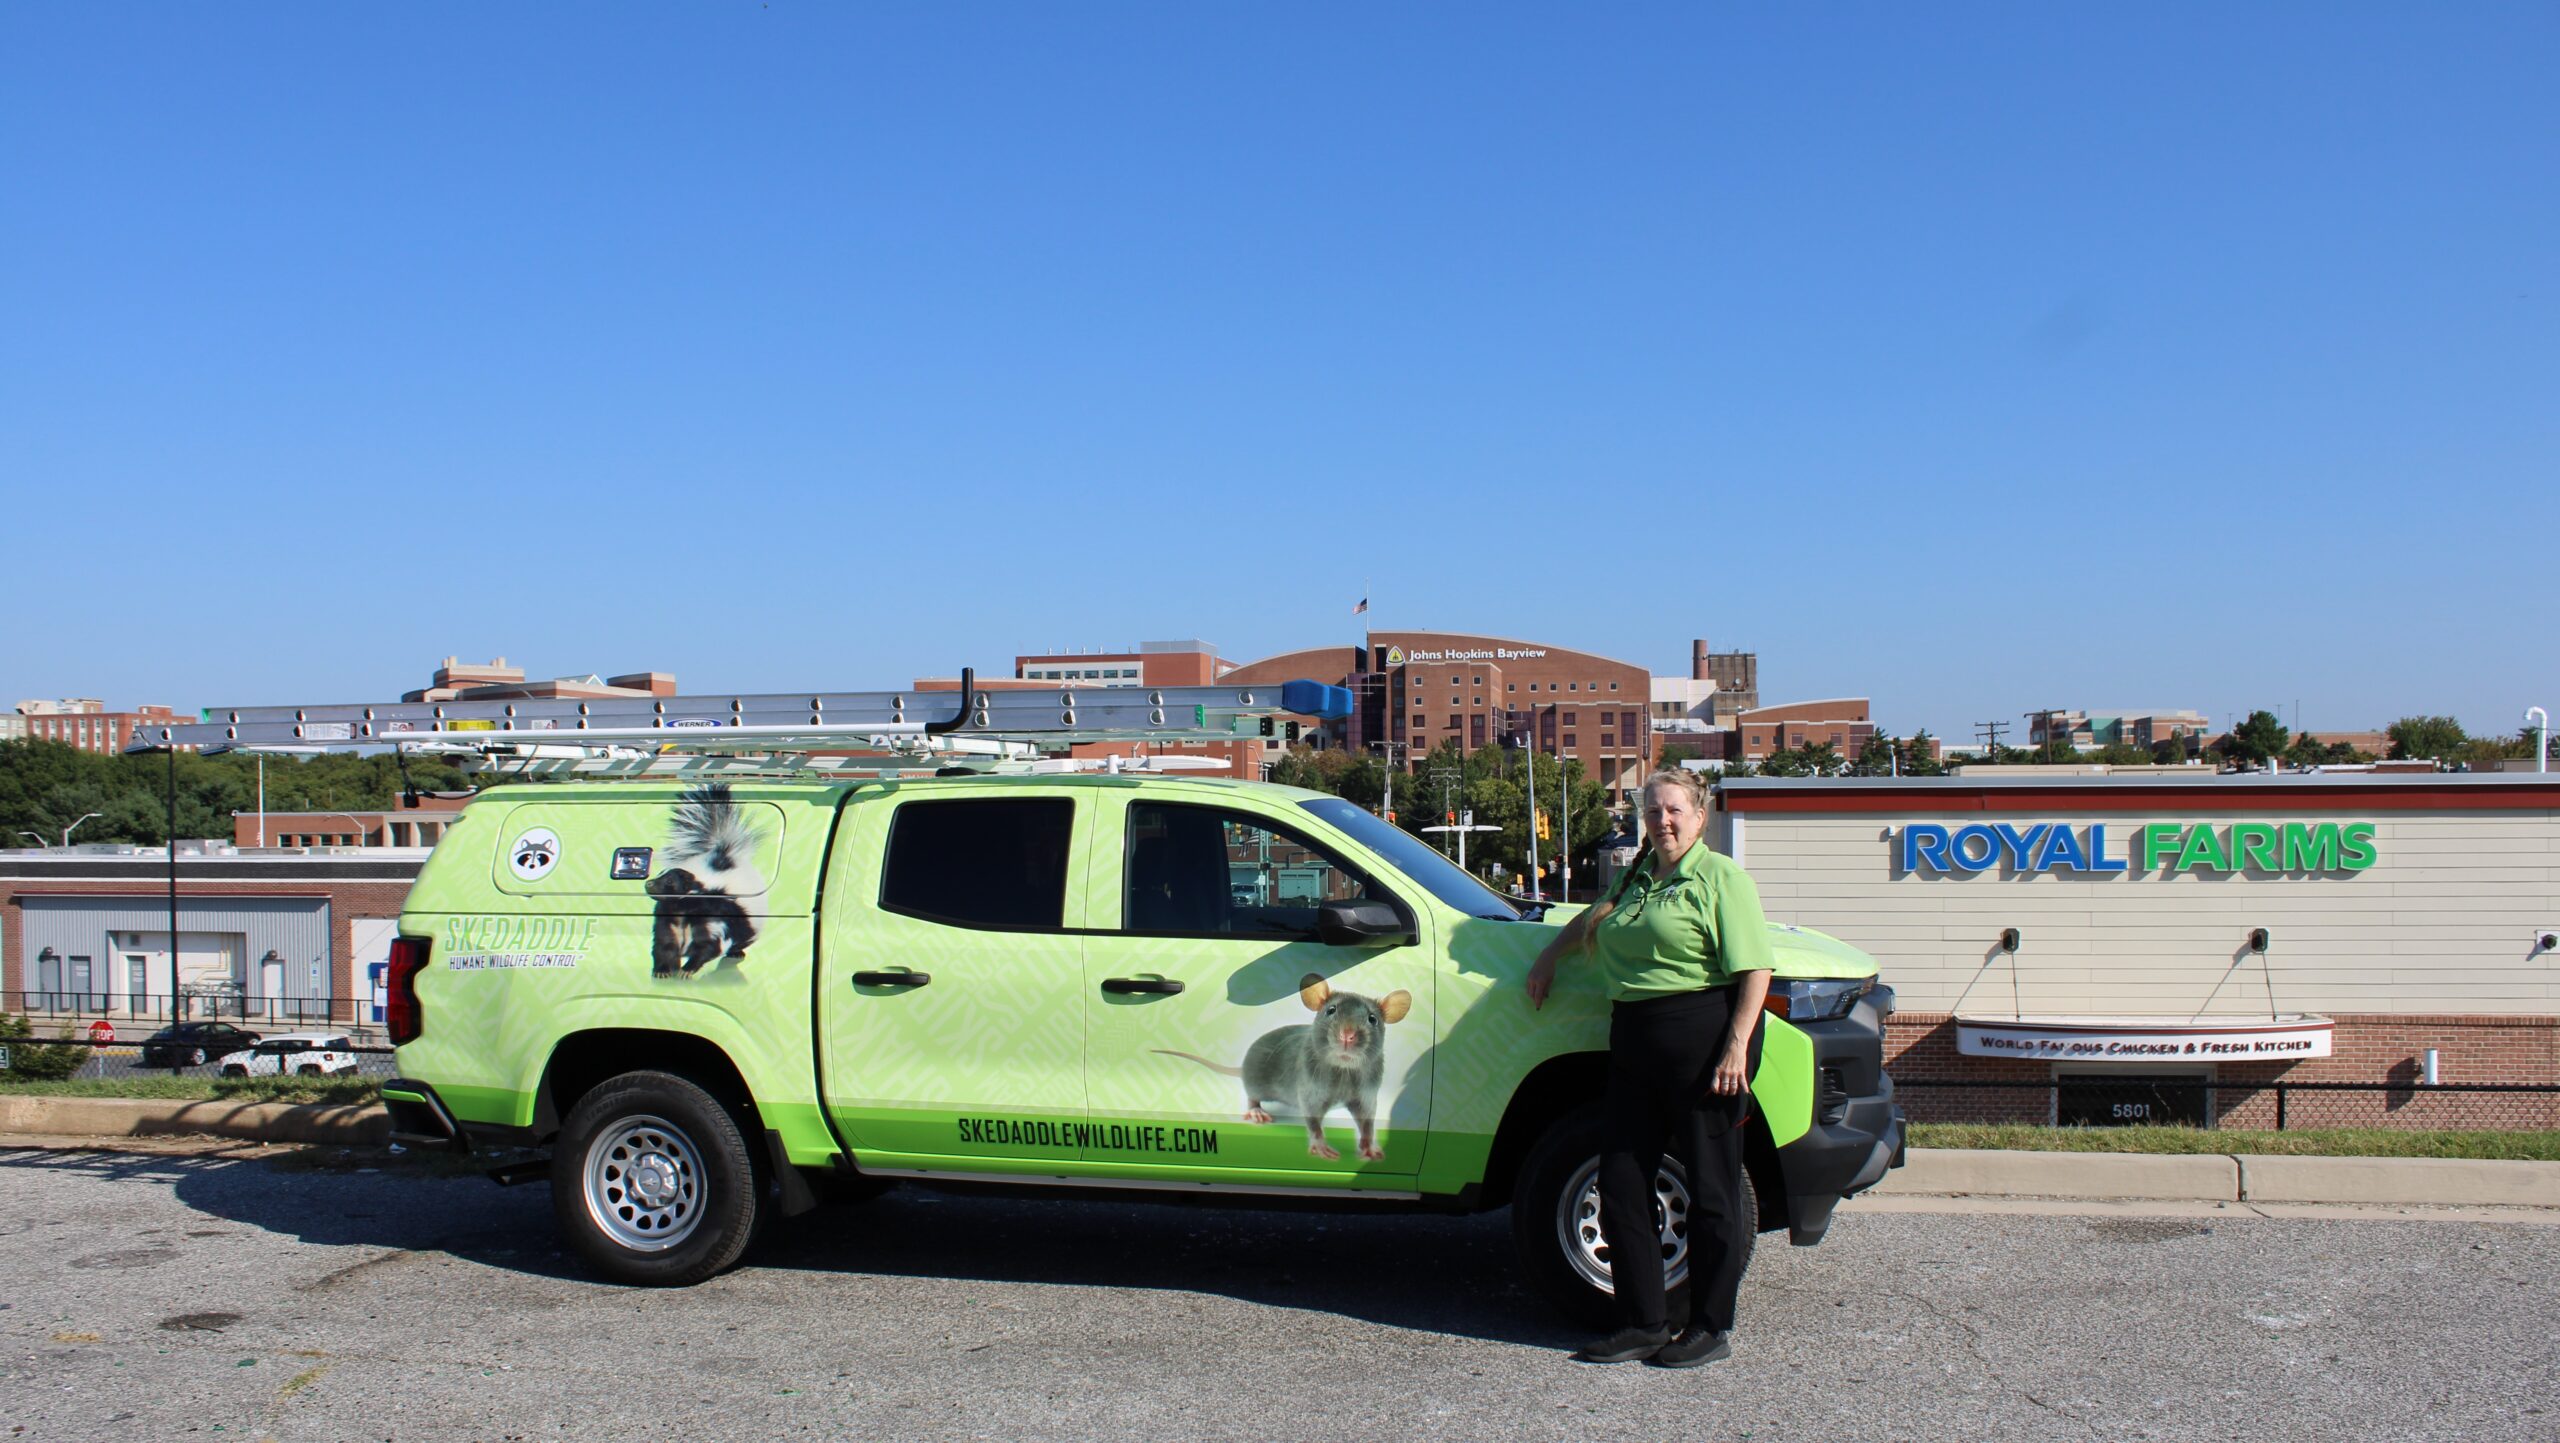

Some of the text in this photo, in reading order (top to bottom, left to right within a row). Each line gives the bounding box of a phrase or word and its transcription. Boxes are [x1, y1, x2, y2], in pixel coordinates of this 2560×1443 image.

[1409, 648, 1546, 662] Johns Hopkins Bayview
[677, 720, 711, 728] WERNER
[1902, 822, 2378, 873] ROYAL FARMS
[445, 916, 598, 952] SKEDADDLE
[450, 955, 485, 970] HUMANE
[489, 954, 529, 968] WILDLIFE
[1980, 1036, 2034, 1050] WORLD
[2109, 1041, 2179, 1054] CHICKEN
[2184, 1042, 2196, 1054] &
[2201, 1042, 2249, 1053] FRESH
[2254, 1040, 2312, 1051] KITCHEN
[2112, 1104, 2150, 1118] 5801
[958, 1118, 1219, 1154] SKEDADDLEWILDLIFE.COM
